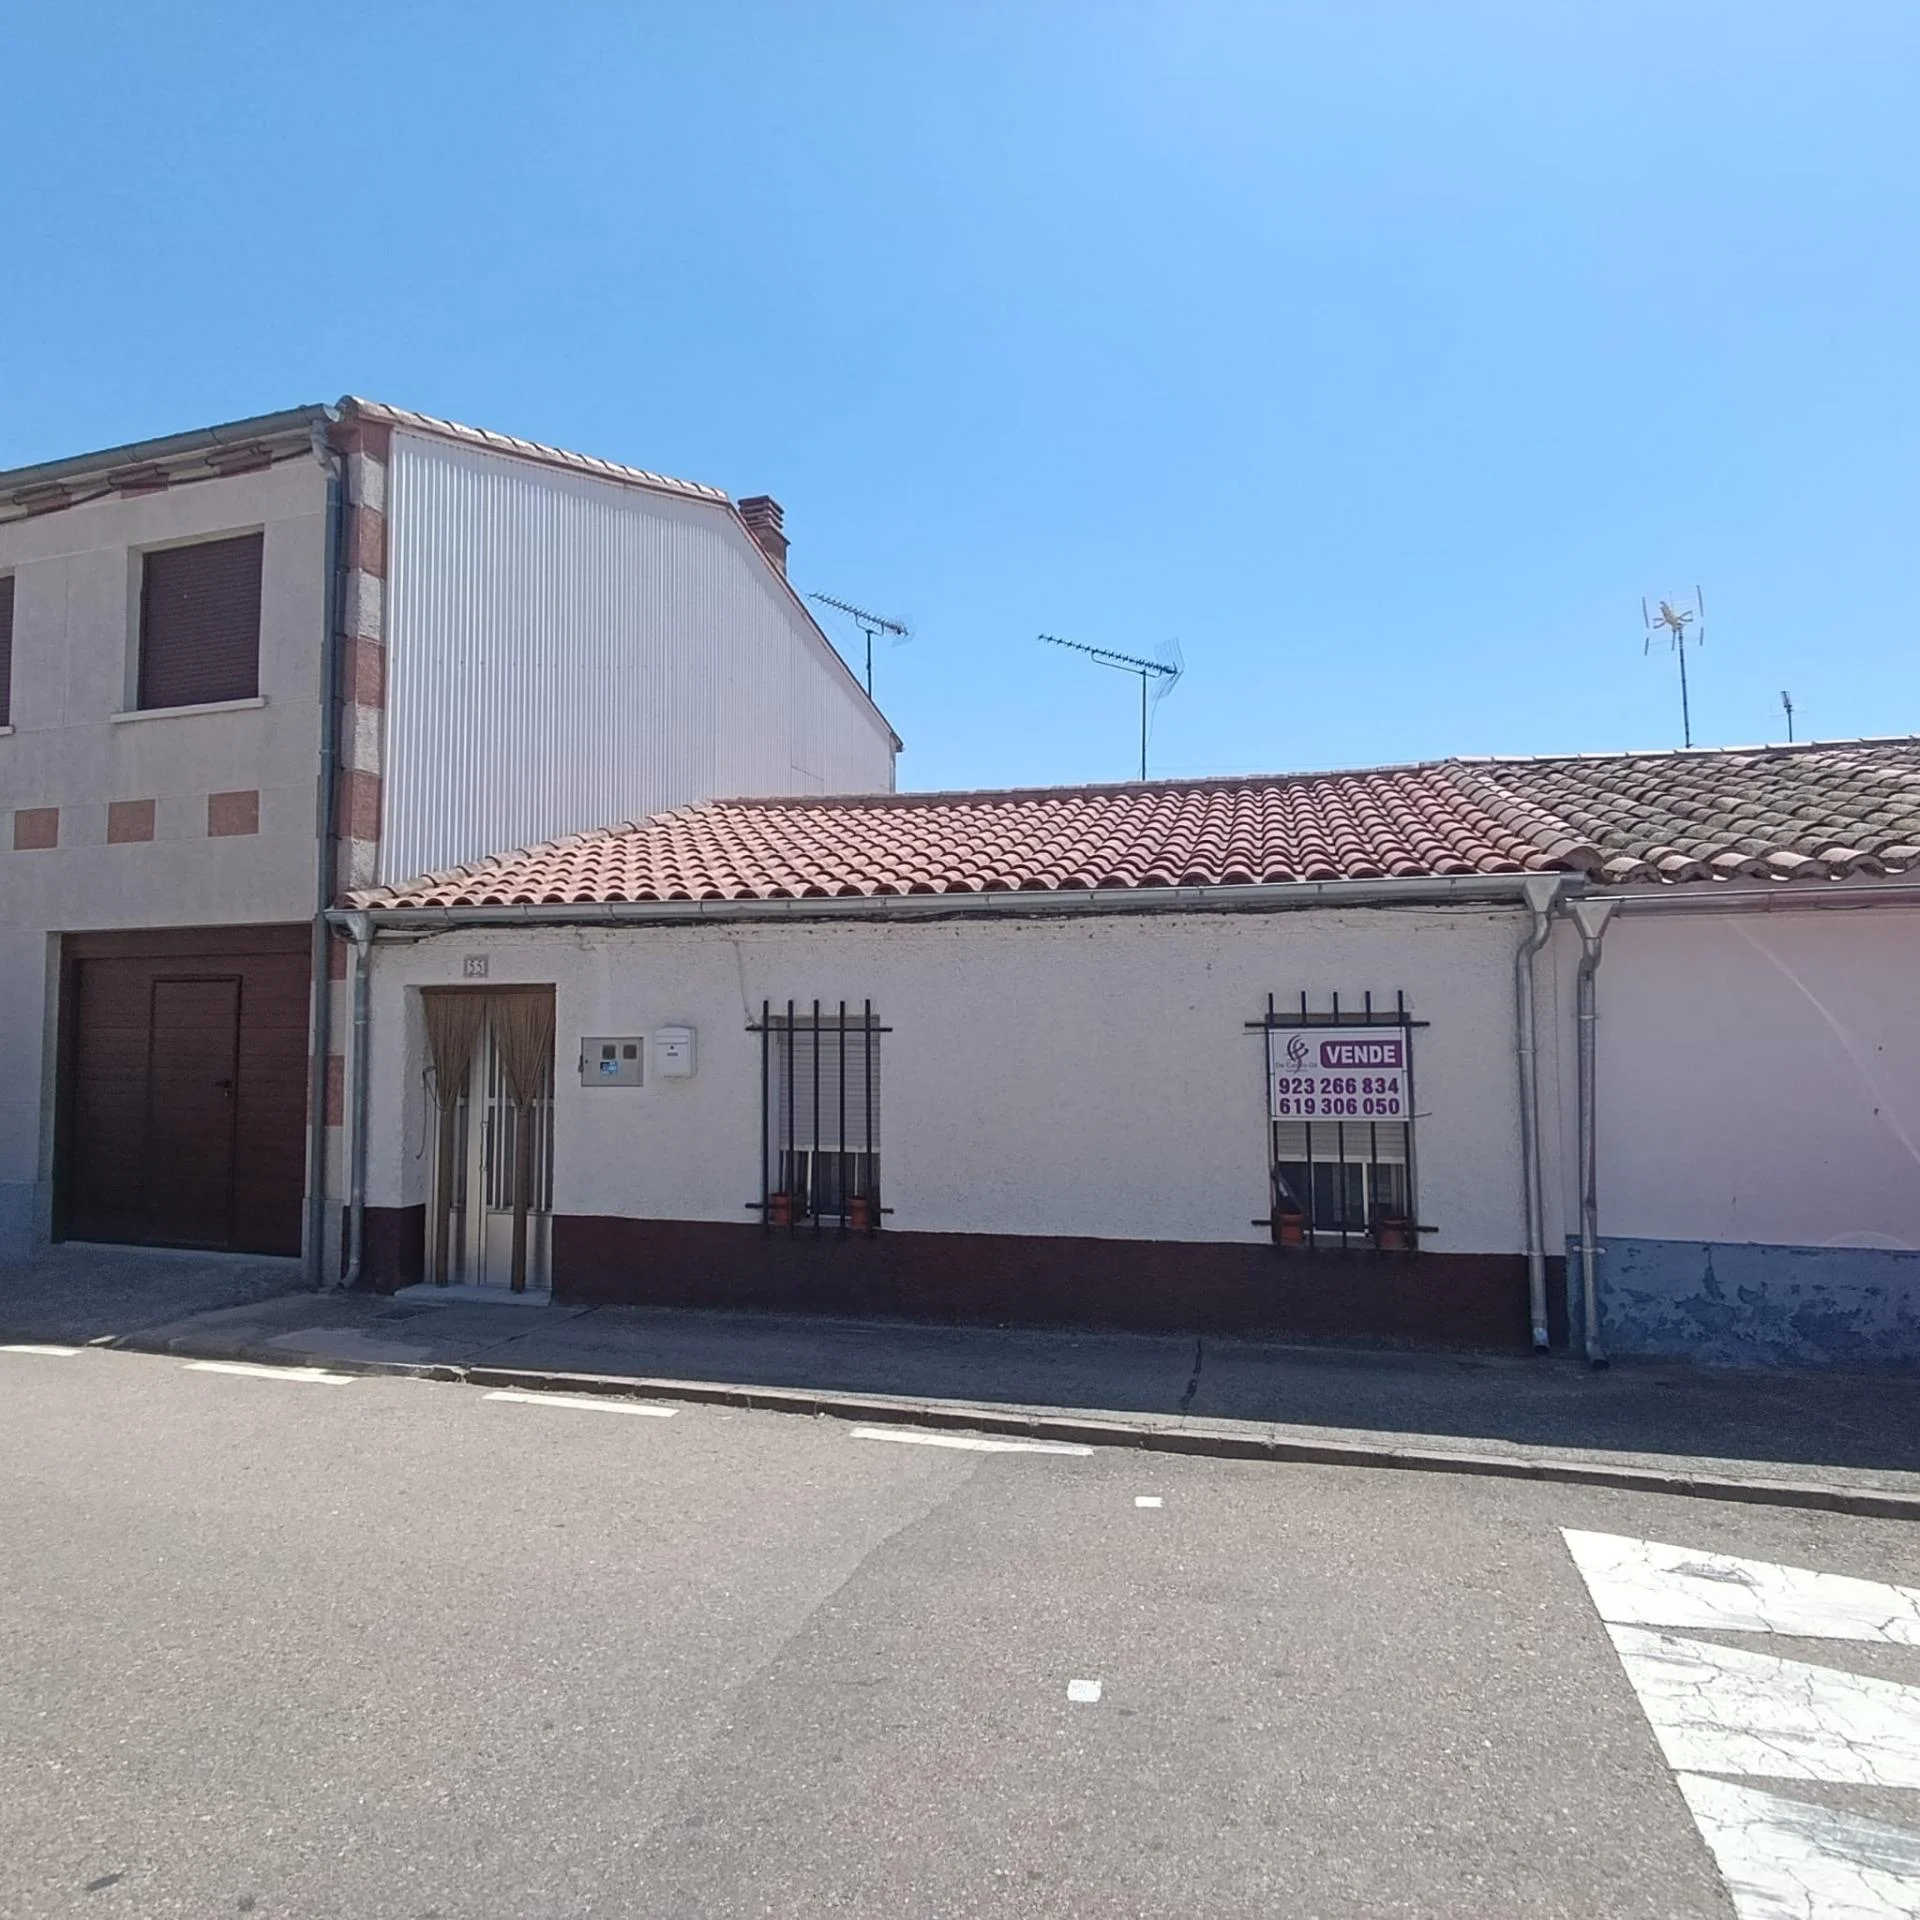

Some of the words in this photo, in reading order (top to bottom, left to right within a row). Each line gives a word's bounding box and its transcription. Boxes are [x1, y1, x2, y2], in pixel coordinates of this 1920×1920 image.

[1326, 1045, 1397, 1064] VENDE
[1279, 1077, 1315, 1095] 923
[1320, 1077, 1357, 1095] 266
[1362, 1077, 1399, 1095] 834
[1279, 1098, 1316, 1115] 619
[1321, 1098, 1358, 1115] 306
[1363, 1098, 1400, 1115] 050
